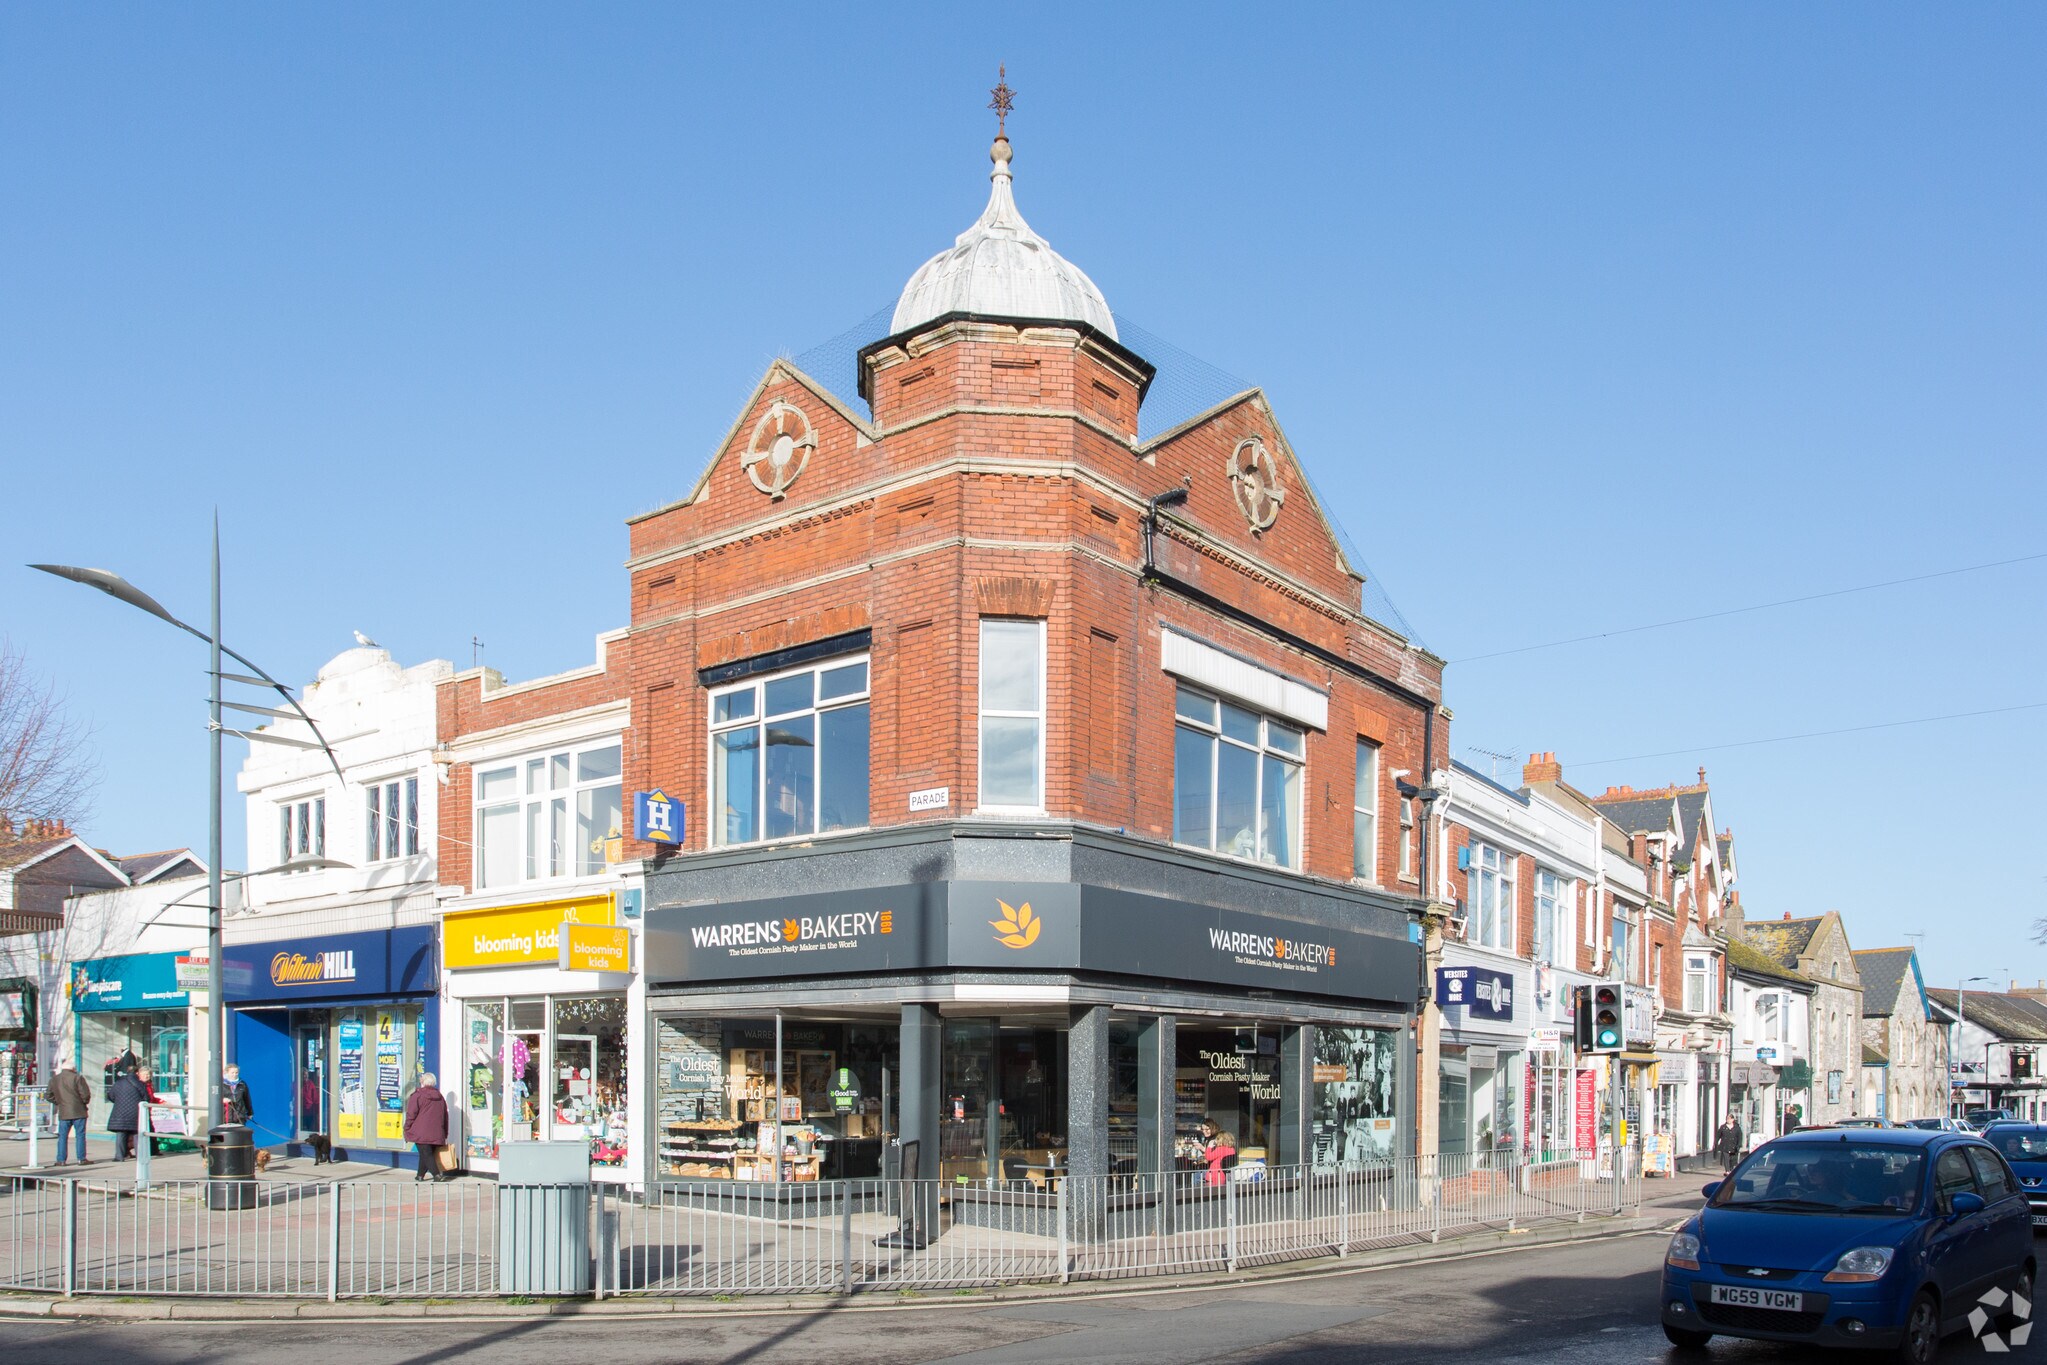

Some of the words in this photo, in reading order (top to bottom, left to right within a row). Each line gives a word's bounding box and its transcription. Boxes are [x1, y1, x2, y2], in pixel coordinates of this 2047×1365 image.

[912, 792, 946, 806] PARADE
[646, 800, 672, 832] H
[691, 920, 781, 948] WARRENS
[801, 911, 880, 940] BAKERY
[880, 910, 892, 935] 1860
[474, 934, 532, 954] blooming
[535, 928, 560, 949] kids
[728, 948, 740, 956] The
[740, 947, 758, 956] Oldest
[758, 946, 781, 954] Cornish
[782, 944, 798, 954] Pasty
[799, 943, 819, 952] Maker
[819, 942, 826, 950] in
[827, 941, 838, 949] the
[838, 940, 858, 948] World
[1209, 927, 1274, 958] WARRENS
[1284, 940, 1330, 964] BAKERY
[1328, 947, 1336, 966] 1860
[574, 942, 623, 958] blooming
[270, 952, 325, 985] William
[324, 950, 356, 979] HILL
[588, 956, 609, 968] kids
[1243, 957, 1256, 966] Oldest
[1256, 959, 1272, 967] Cornish
[1272, 961, 1283, 969] Pasty
[1444, 970, 1468, 978] WEBSITES
[1449, 979, 1463, 992] &
[1448, 993, 1462, 1001] MORE
[380, 1017, 390, 1039] 4
[379, 1056, 396, 1064] MORE
[681, 1056, 719, 1072] Oldest
[1200, 1050, 1211, 1059] The
[1211, 1052, 1246, 1069] Oldest
[679, 1074, 705, 1082] Cornish
[706, 1074, 725, 1085] Pasty
[1209, 1072, 1233, 1082] Cornish
[1234, 1072, 1250, 1083] Pasty
[1252, 1072, 1271, 1082] Maker
[725, 1085, 762, 1100] World
[1250, 1084, 1280, 1099] World
[1719, 1288, 1759, 1304] WG59
[1764, 1292, 1795, 1308] VGM
